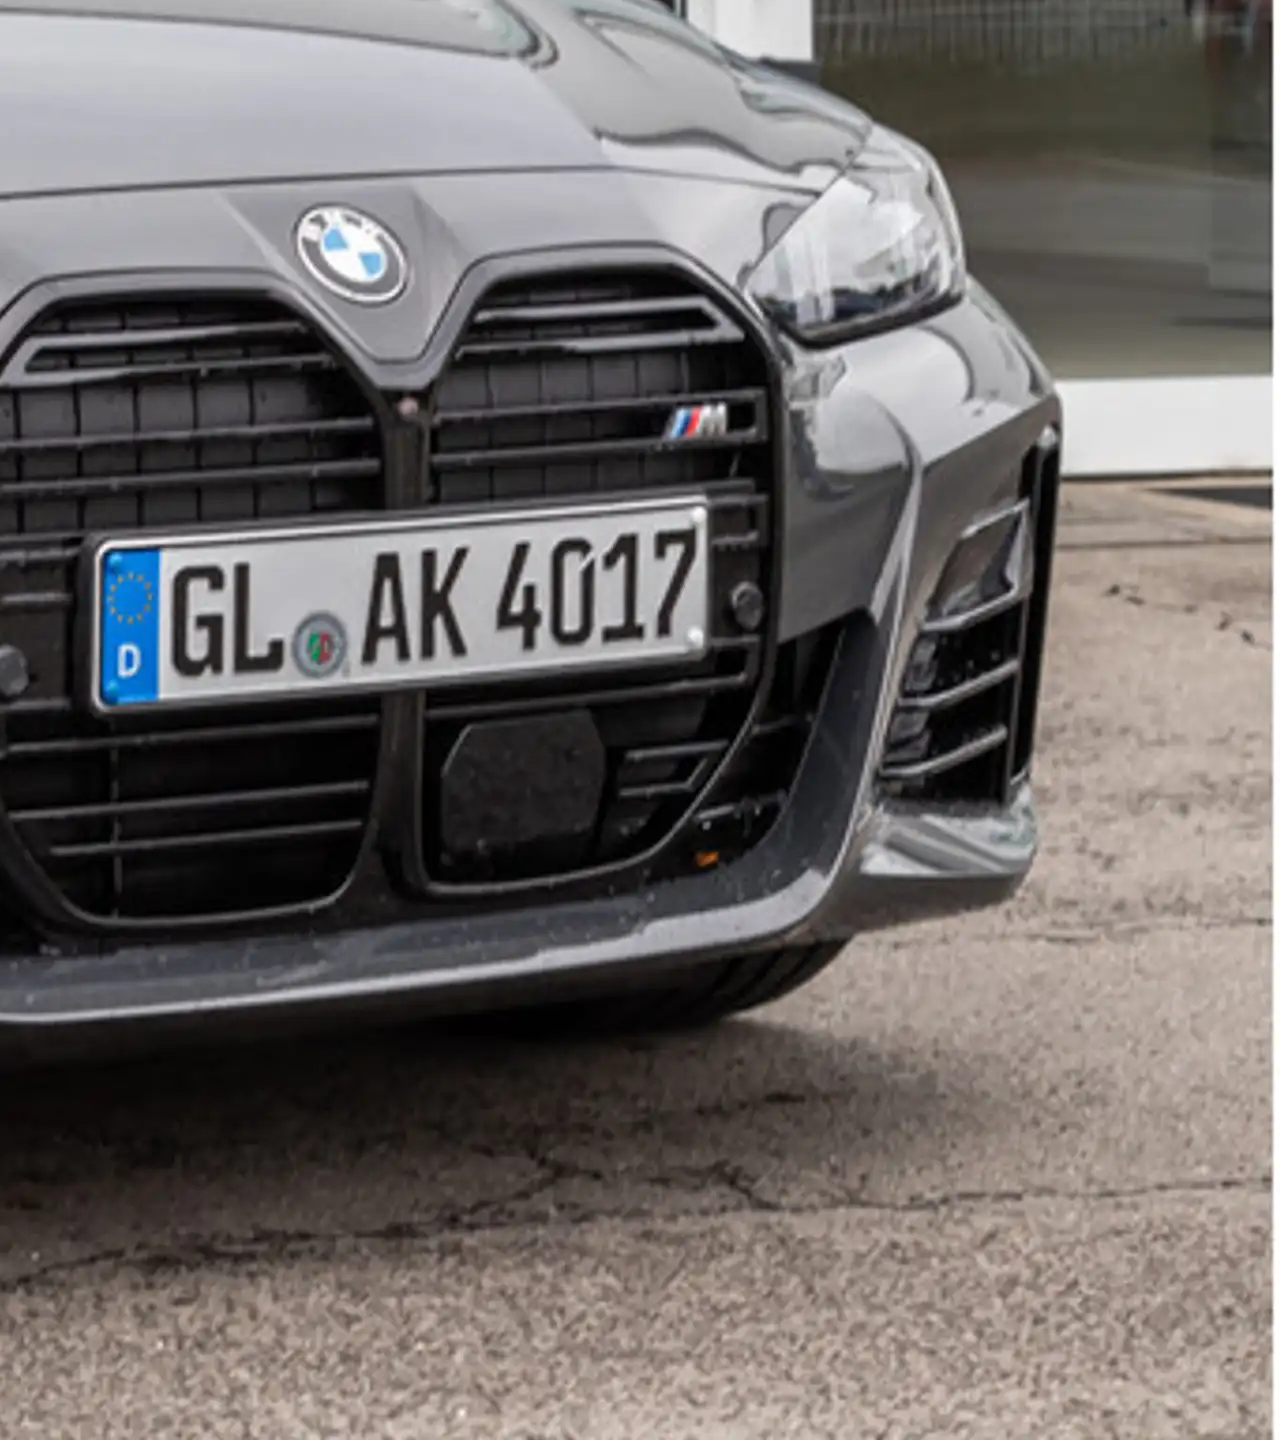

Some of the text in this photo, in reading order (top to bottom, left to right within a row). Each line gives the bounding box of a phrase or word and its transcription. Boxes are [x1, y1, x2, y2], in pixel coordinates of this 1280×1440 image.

[171, 527, 700, 678] GL AK 4017
[116, 642, 142, 679] D
